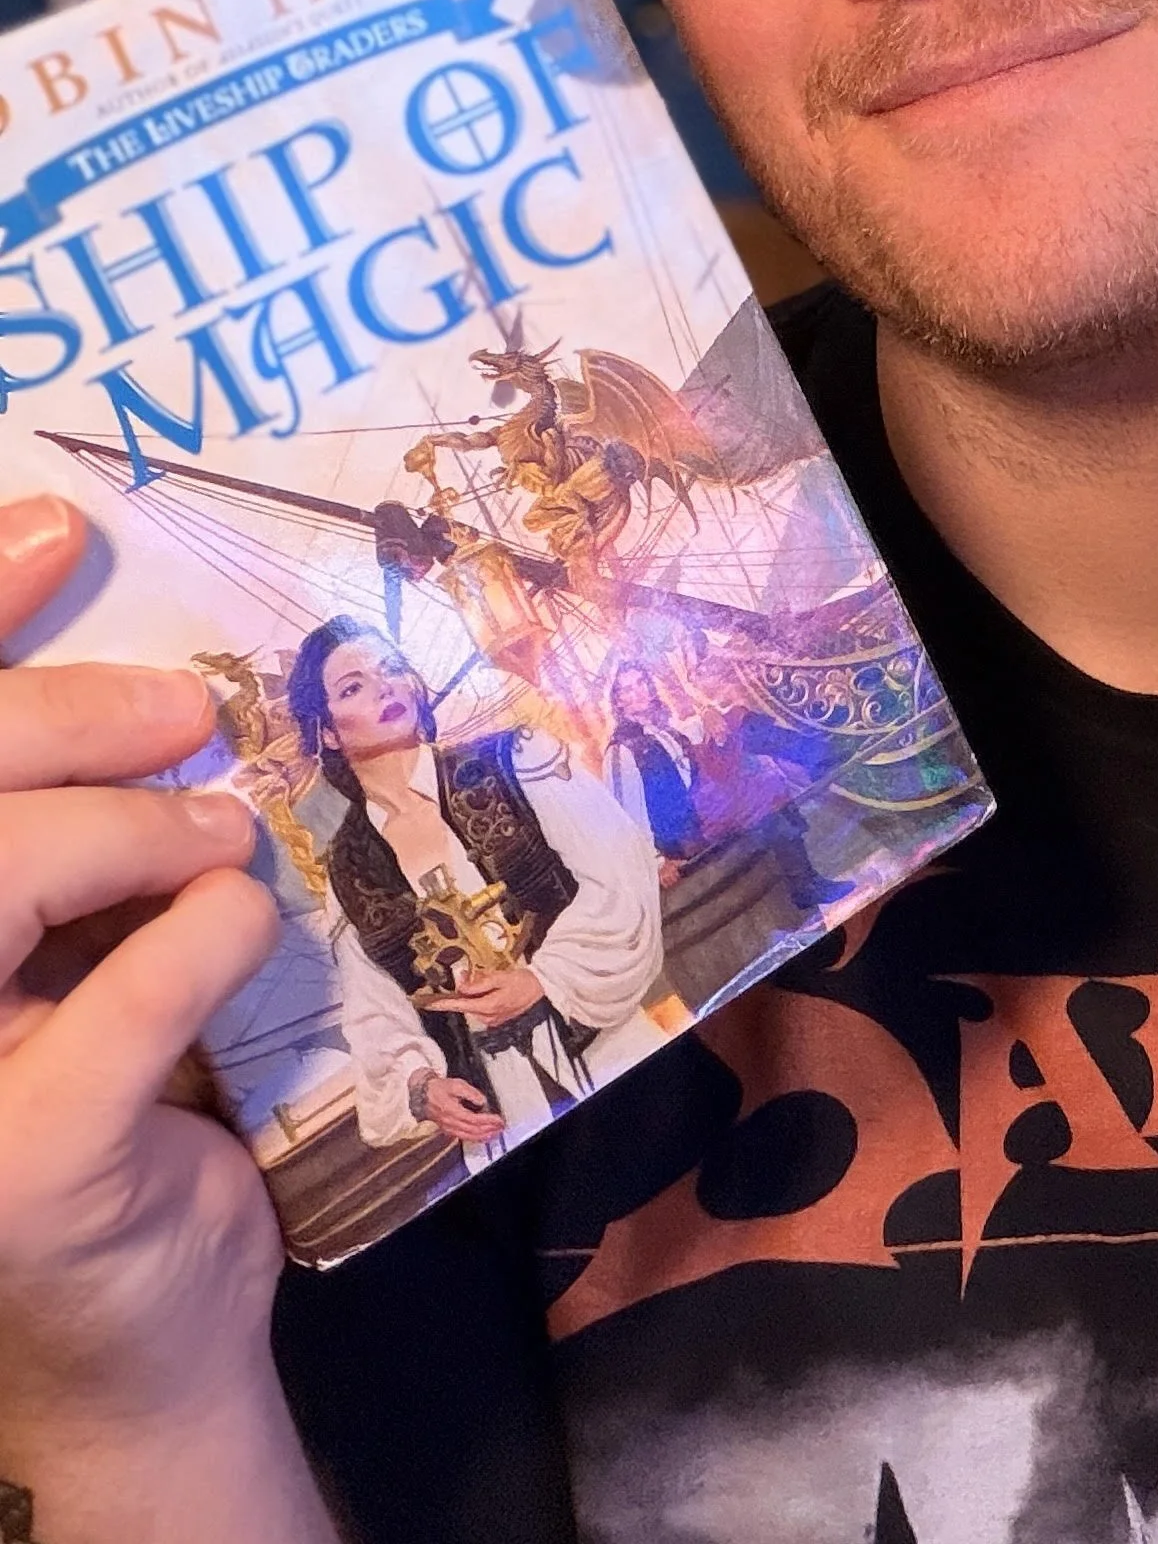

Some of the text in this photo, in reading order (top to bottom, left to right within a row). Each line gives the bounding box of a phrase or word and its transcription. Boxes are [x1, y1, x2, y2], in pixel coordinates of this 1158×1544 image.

[66, 128, 146, 182] THE
[143, 63, 285, 146] LIVESHIP
[404, 6, 600, 177] OF
[84, 147, 616, 494] MAGIC
